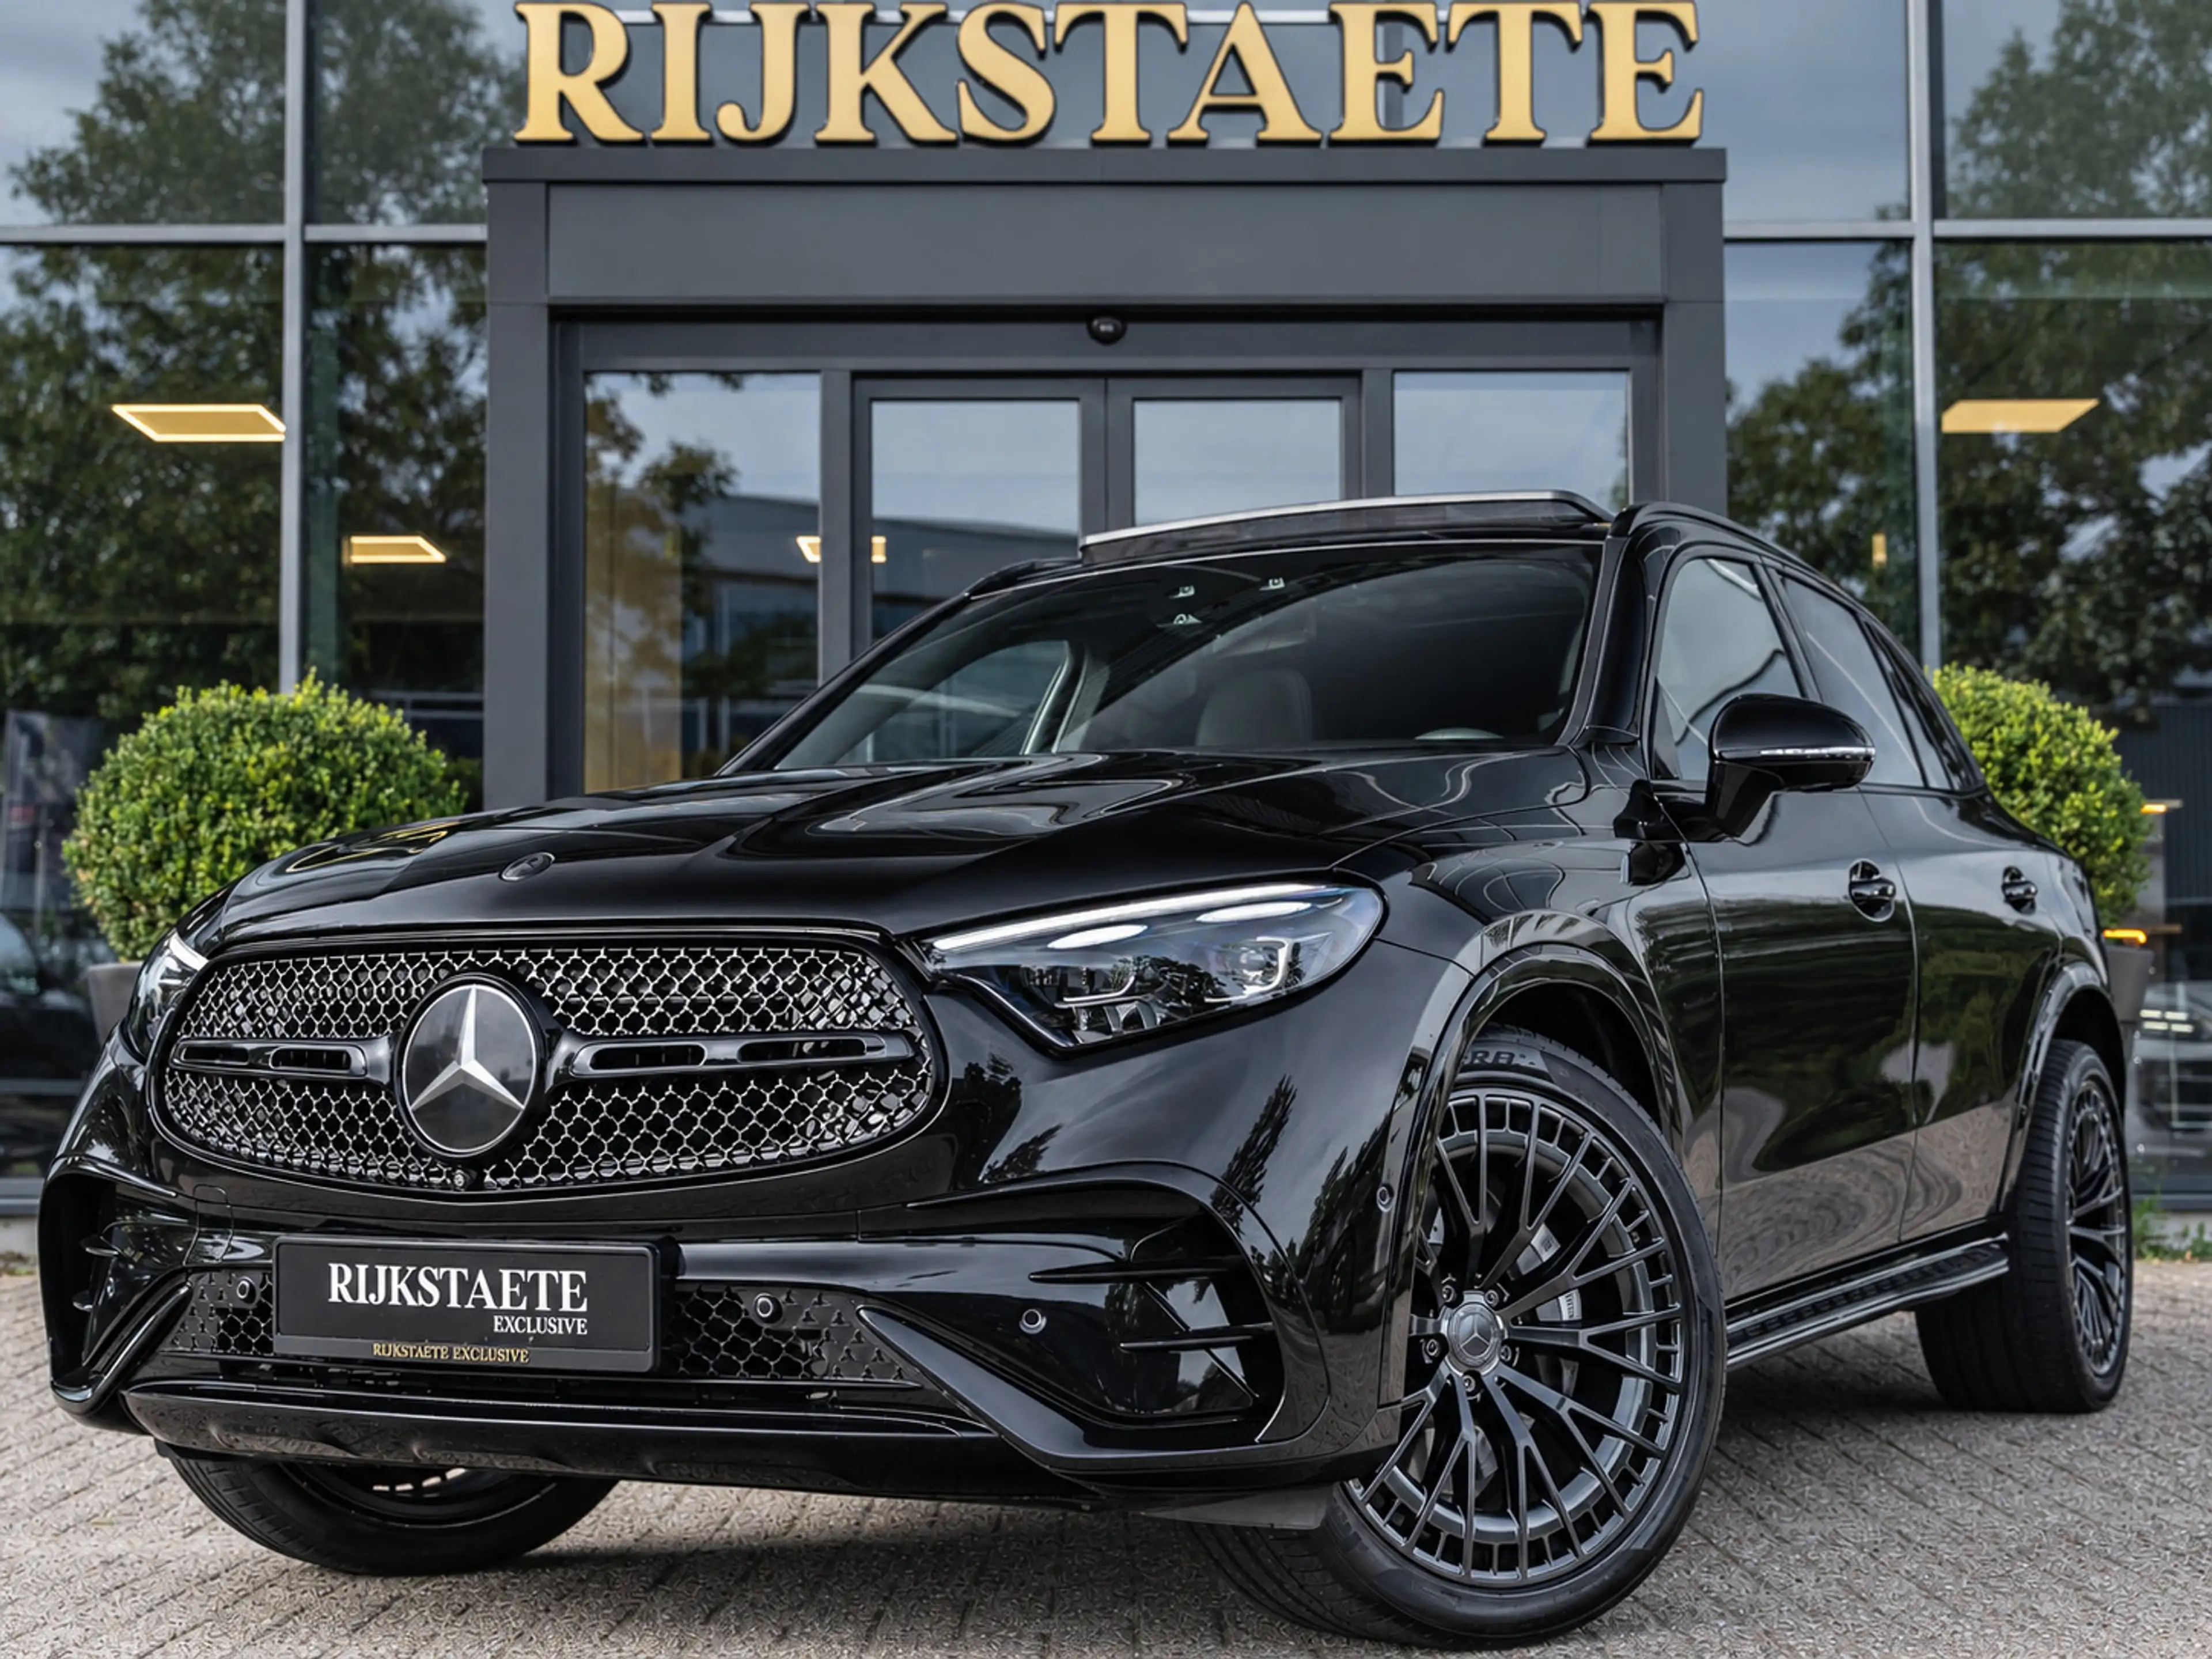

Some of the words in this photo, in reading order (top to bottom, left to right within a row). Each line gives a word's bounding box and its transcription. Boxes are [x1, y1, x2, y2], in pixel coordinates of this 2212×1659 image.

[514, 1, 1706, 144] RIJKSTAETE
[328, 1263, 588, 1312] RIJKSTAETE
[494, 1315, 588, 1335] EXCLUSIVE
[452, 1346, 529, 1363] EXCLUSIVE
